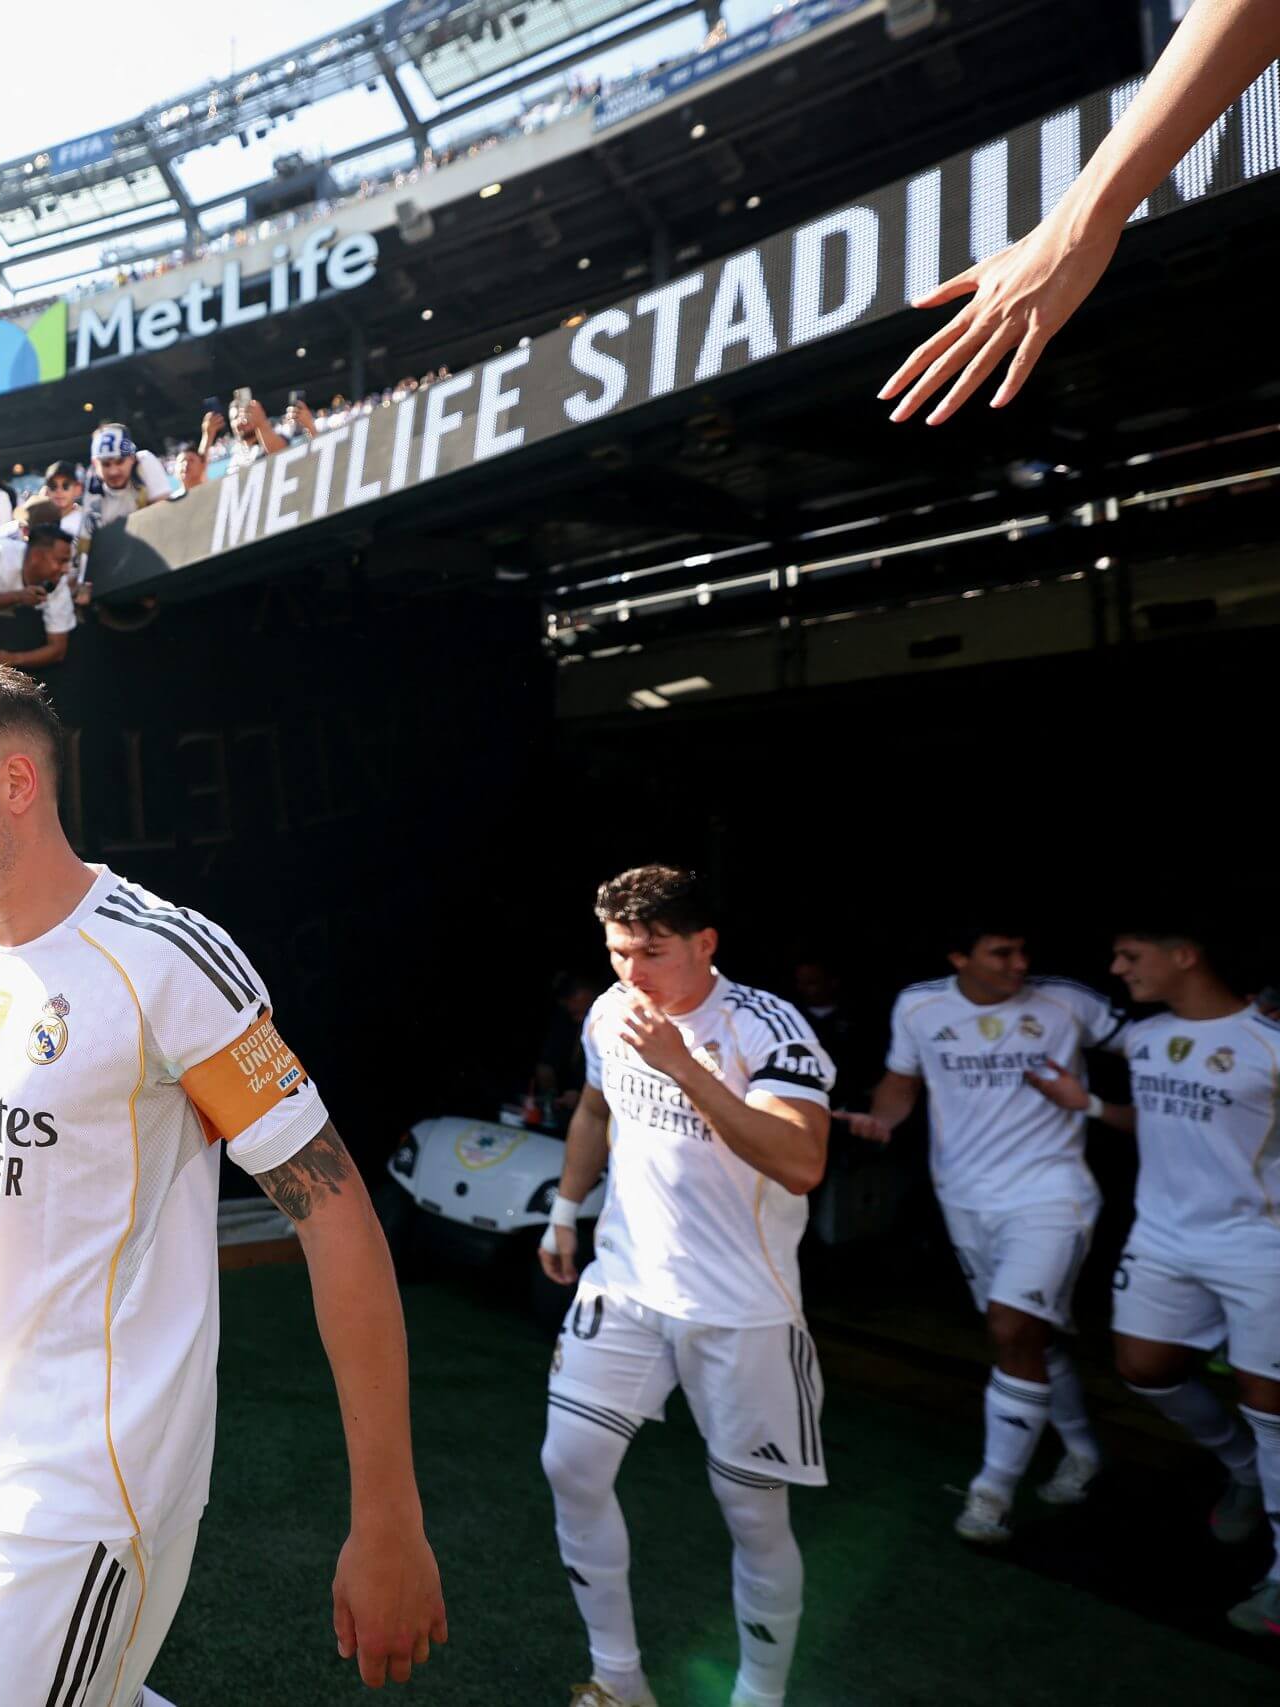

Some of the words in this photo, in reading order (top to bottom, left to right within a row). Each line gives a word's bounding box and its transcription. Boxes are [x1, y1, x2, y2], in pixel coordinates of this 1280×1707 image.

[74, 226, 379, 370] MetLife
[211, 346, 531, 556] METLIFE
[246, 1071, 274, 1093] the
[279, 1068, 300, 1089] FIFA
